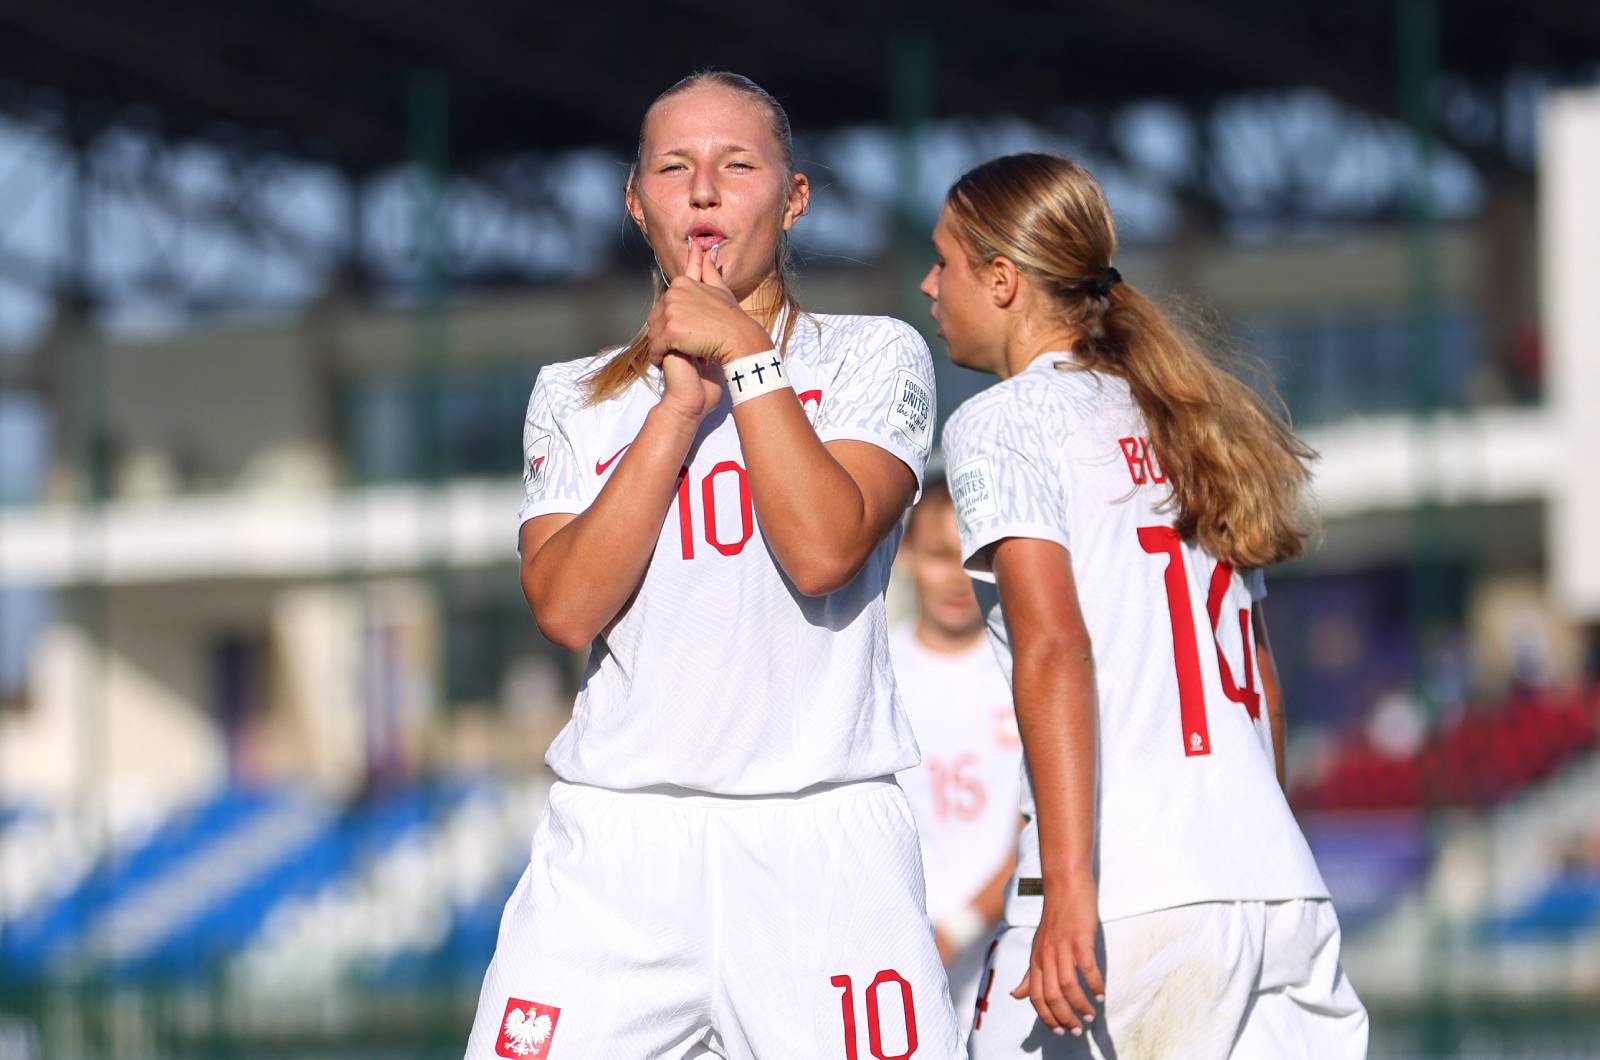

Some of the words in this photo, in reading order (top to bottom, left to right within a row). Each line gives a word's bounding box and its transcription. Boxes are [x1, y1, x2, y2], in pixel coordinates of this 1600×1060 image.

[896, 403, 910, 417] the
[910, 410, 928, 432] World
[902, 389, 929, 420] UNITES
[904, 379, 930, 405] FOOTBALL
[677, 460, 754, 561] 10
[1136, 525, 1261, 758] 14
[928, 752, 987, 823] 15
[830, 968, 919, 1060] 10
